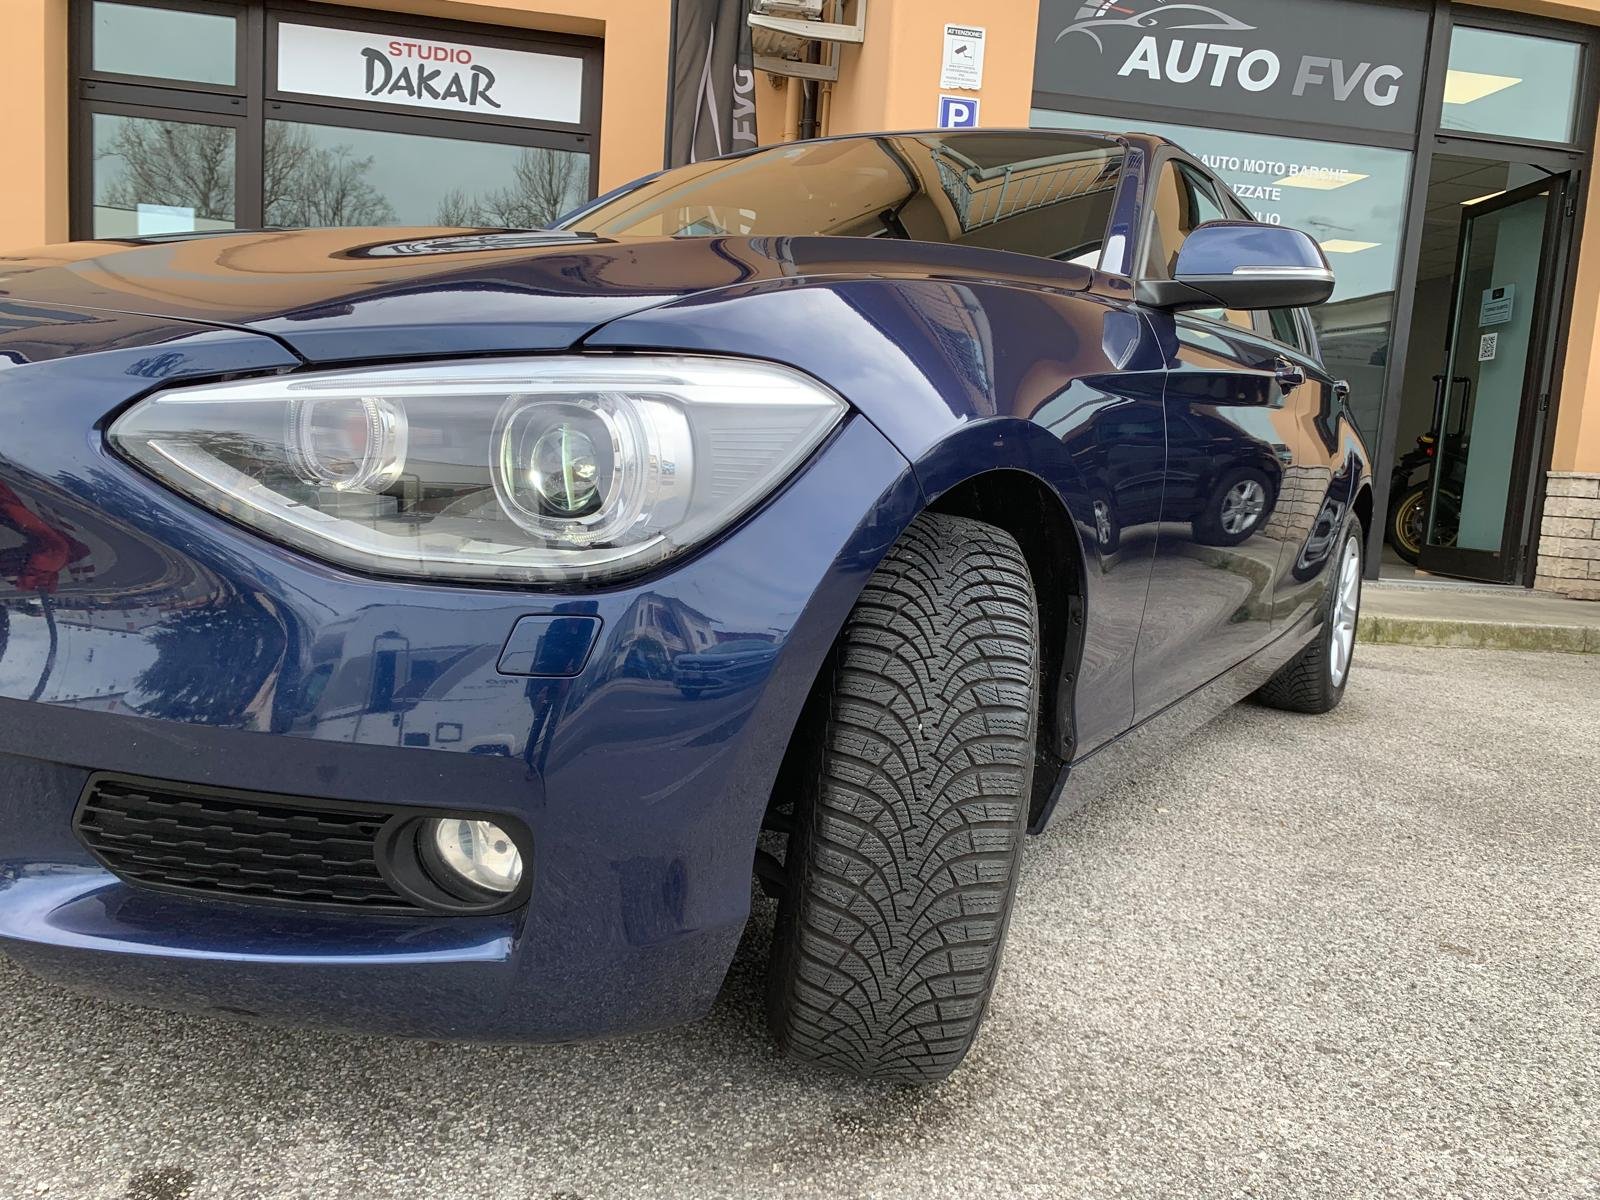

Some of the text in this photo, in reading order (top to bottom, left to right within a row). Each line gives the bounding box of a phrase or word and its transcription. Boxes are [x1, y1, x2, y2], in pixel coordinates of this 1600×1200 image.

[388, 41, 473, 65] STUDIO
[1117, 35, 1404, 107] AUTO FVG
[361, 47, 502, 109] DAKAR
[732, 63, 757, 144] FVG
[947, 102, 970, 128] P
[1201, 154, 1348, 181] AUTO MOTO BARCHE
